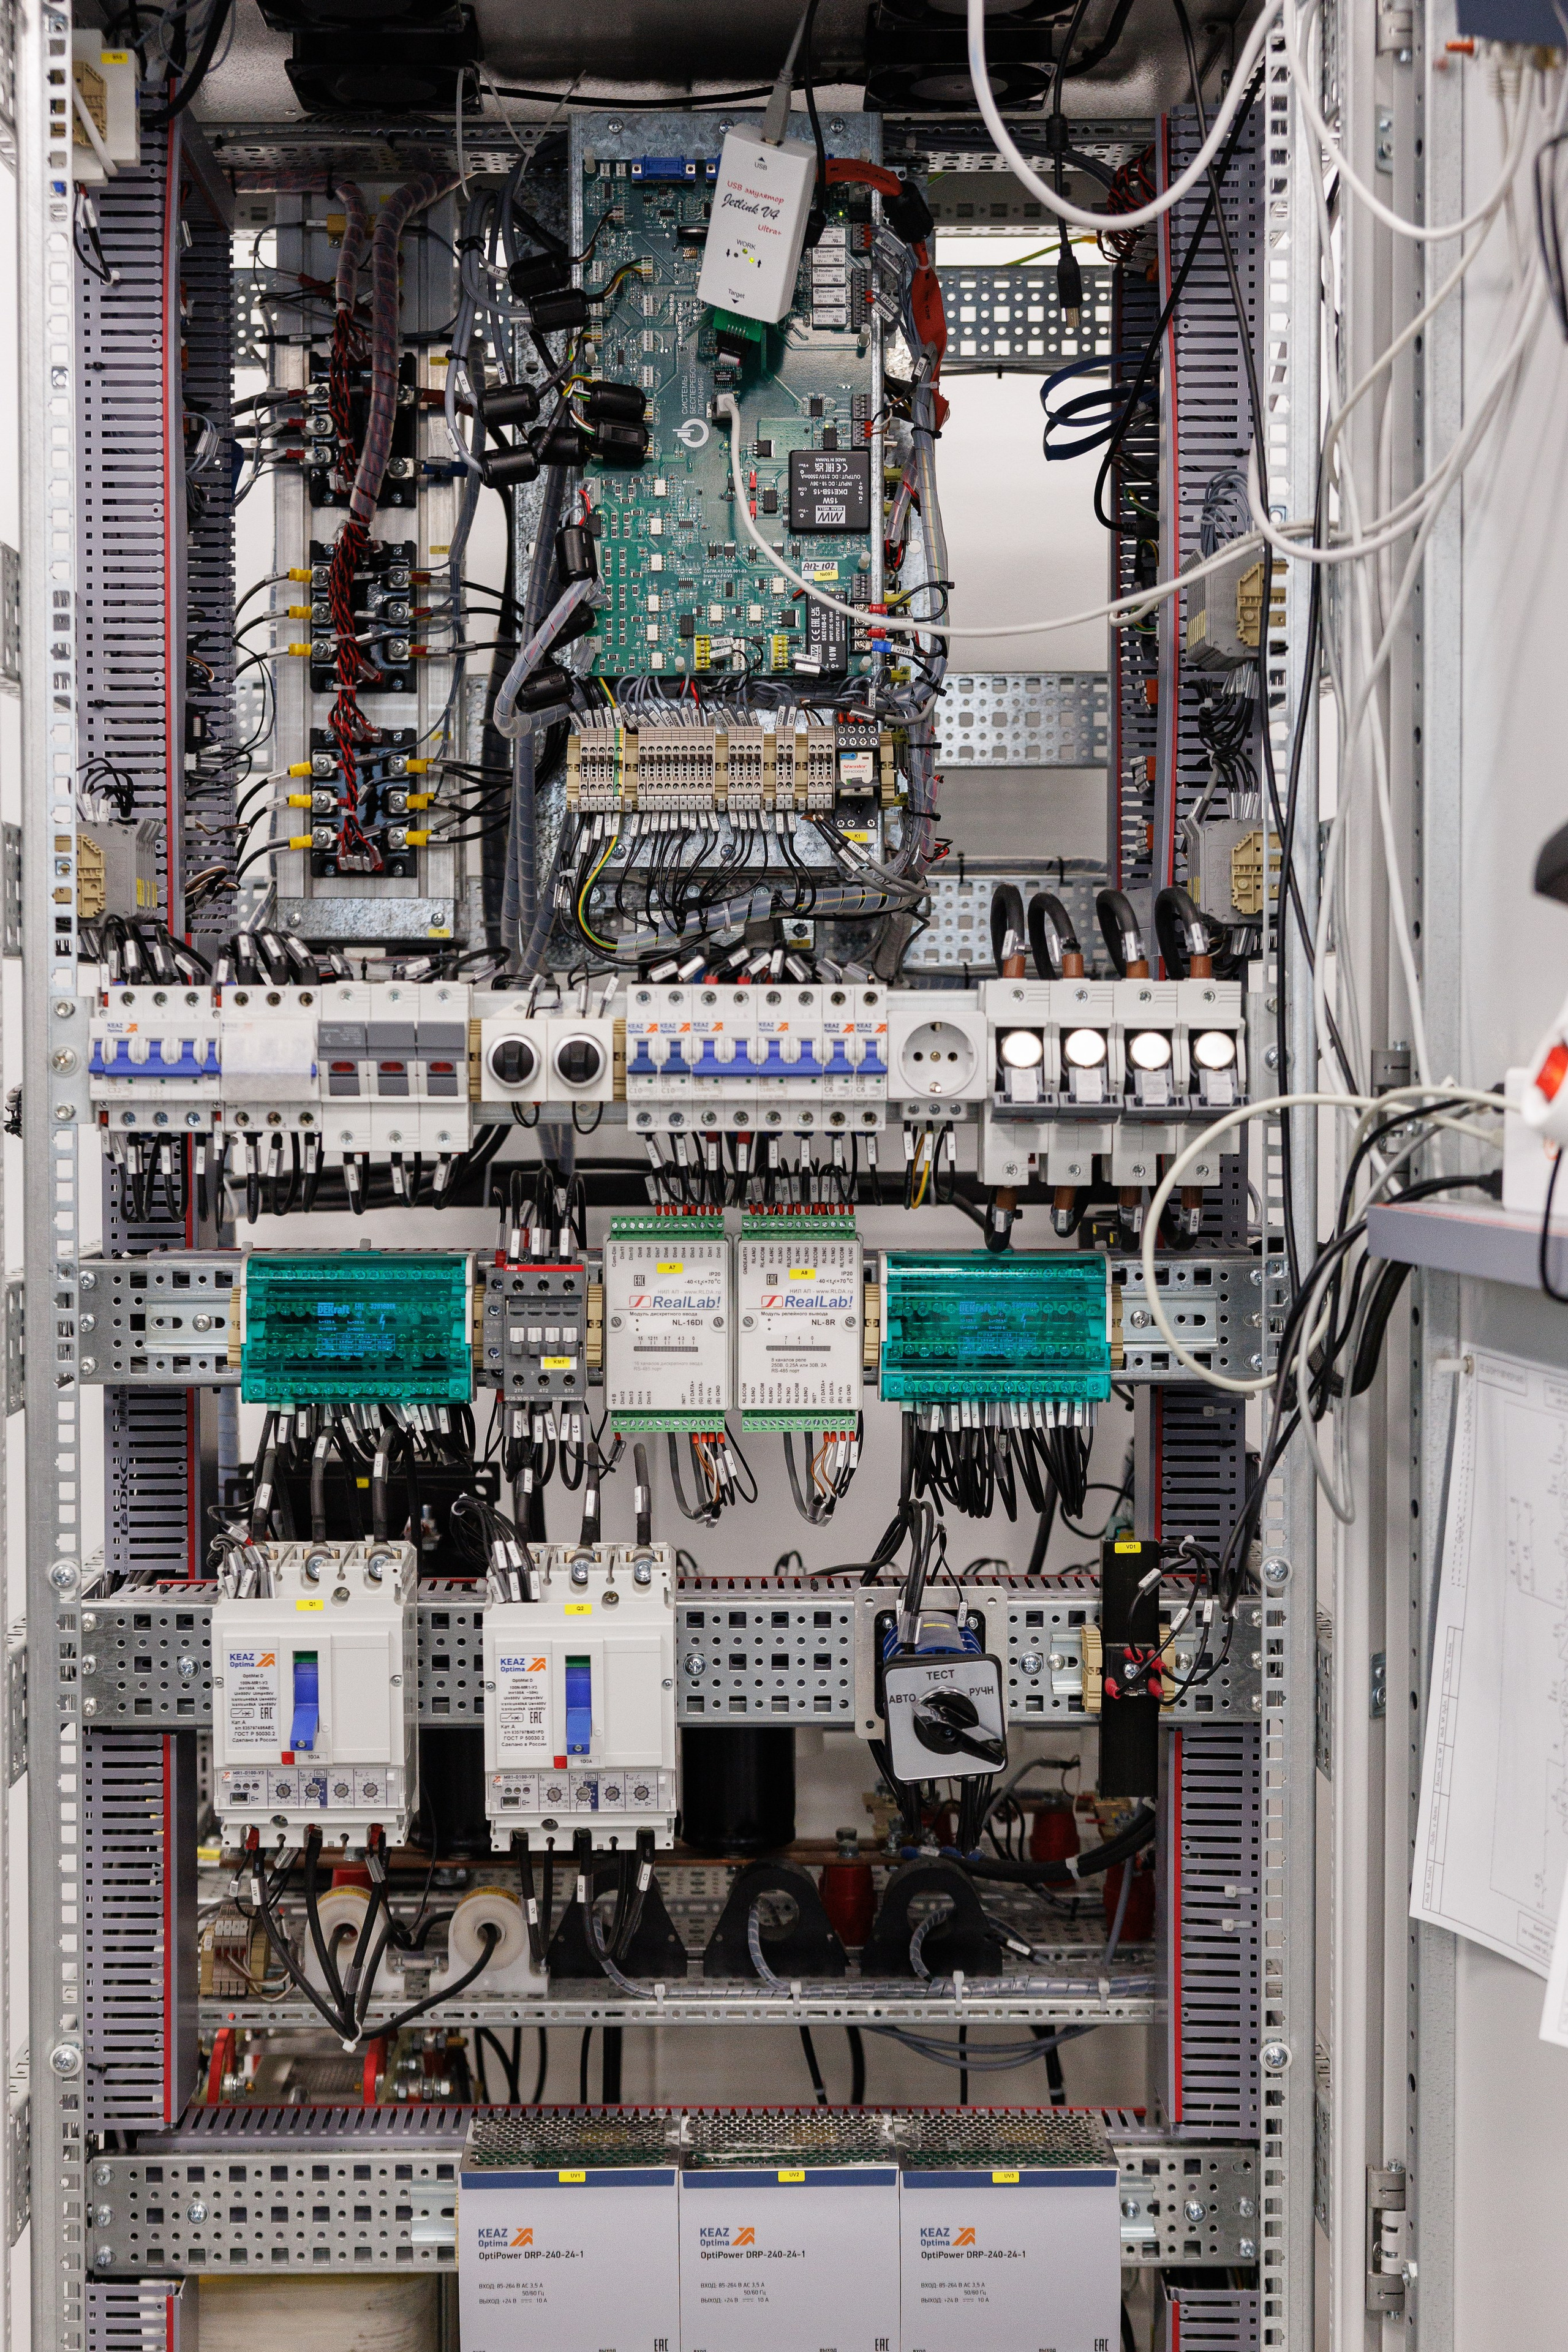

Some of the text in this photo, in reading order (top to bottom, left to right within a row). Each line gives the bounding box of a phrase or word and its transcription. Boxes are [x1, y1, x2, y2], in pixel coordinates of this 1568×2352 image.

[754, 162, 767, 171] USB
[727, 180, 784, 205] USB эмулятор
[722, 194, 780, 219] Jetlink V4
[758, 224, 782, 235] Ultra+
[736, 239, 756, 250] WORK
[728, 288, 745, 299] Target
[878, 307, 889, 319] +24V1
[853, 845, 863, 854] A101
[843, 854, 854, 864] A102
[653, 1296, 720, 1308] RealLab!
[785, 1295, 853, 1308] RealLab!
[926, 1670, 954, 1680] ТЕСТ
[969, 1686, 993, 1696] РУЧН
[889, 1694, 916, 1703] АВТО
[478, 2229, 508, 2237] KEAZ
[700, 2228, 729, 2237] KEAZ
[921, 2228, 950, 2237] KEAZ
[478, 2240, 508, 2248] Optima
[479, 2252, 522, 2261] OptiPower
[701, 2252, 744, 2260] OptiPower
[921, 2252, 964, 2260] OptiPower
